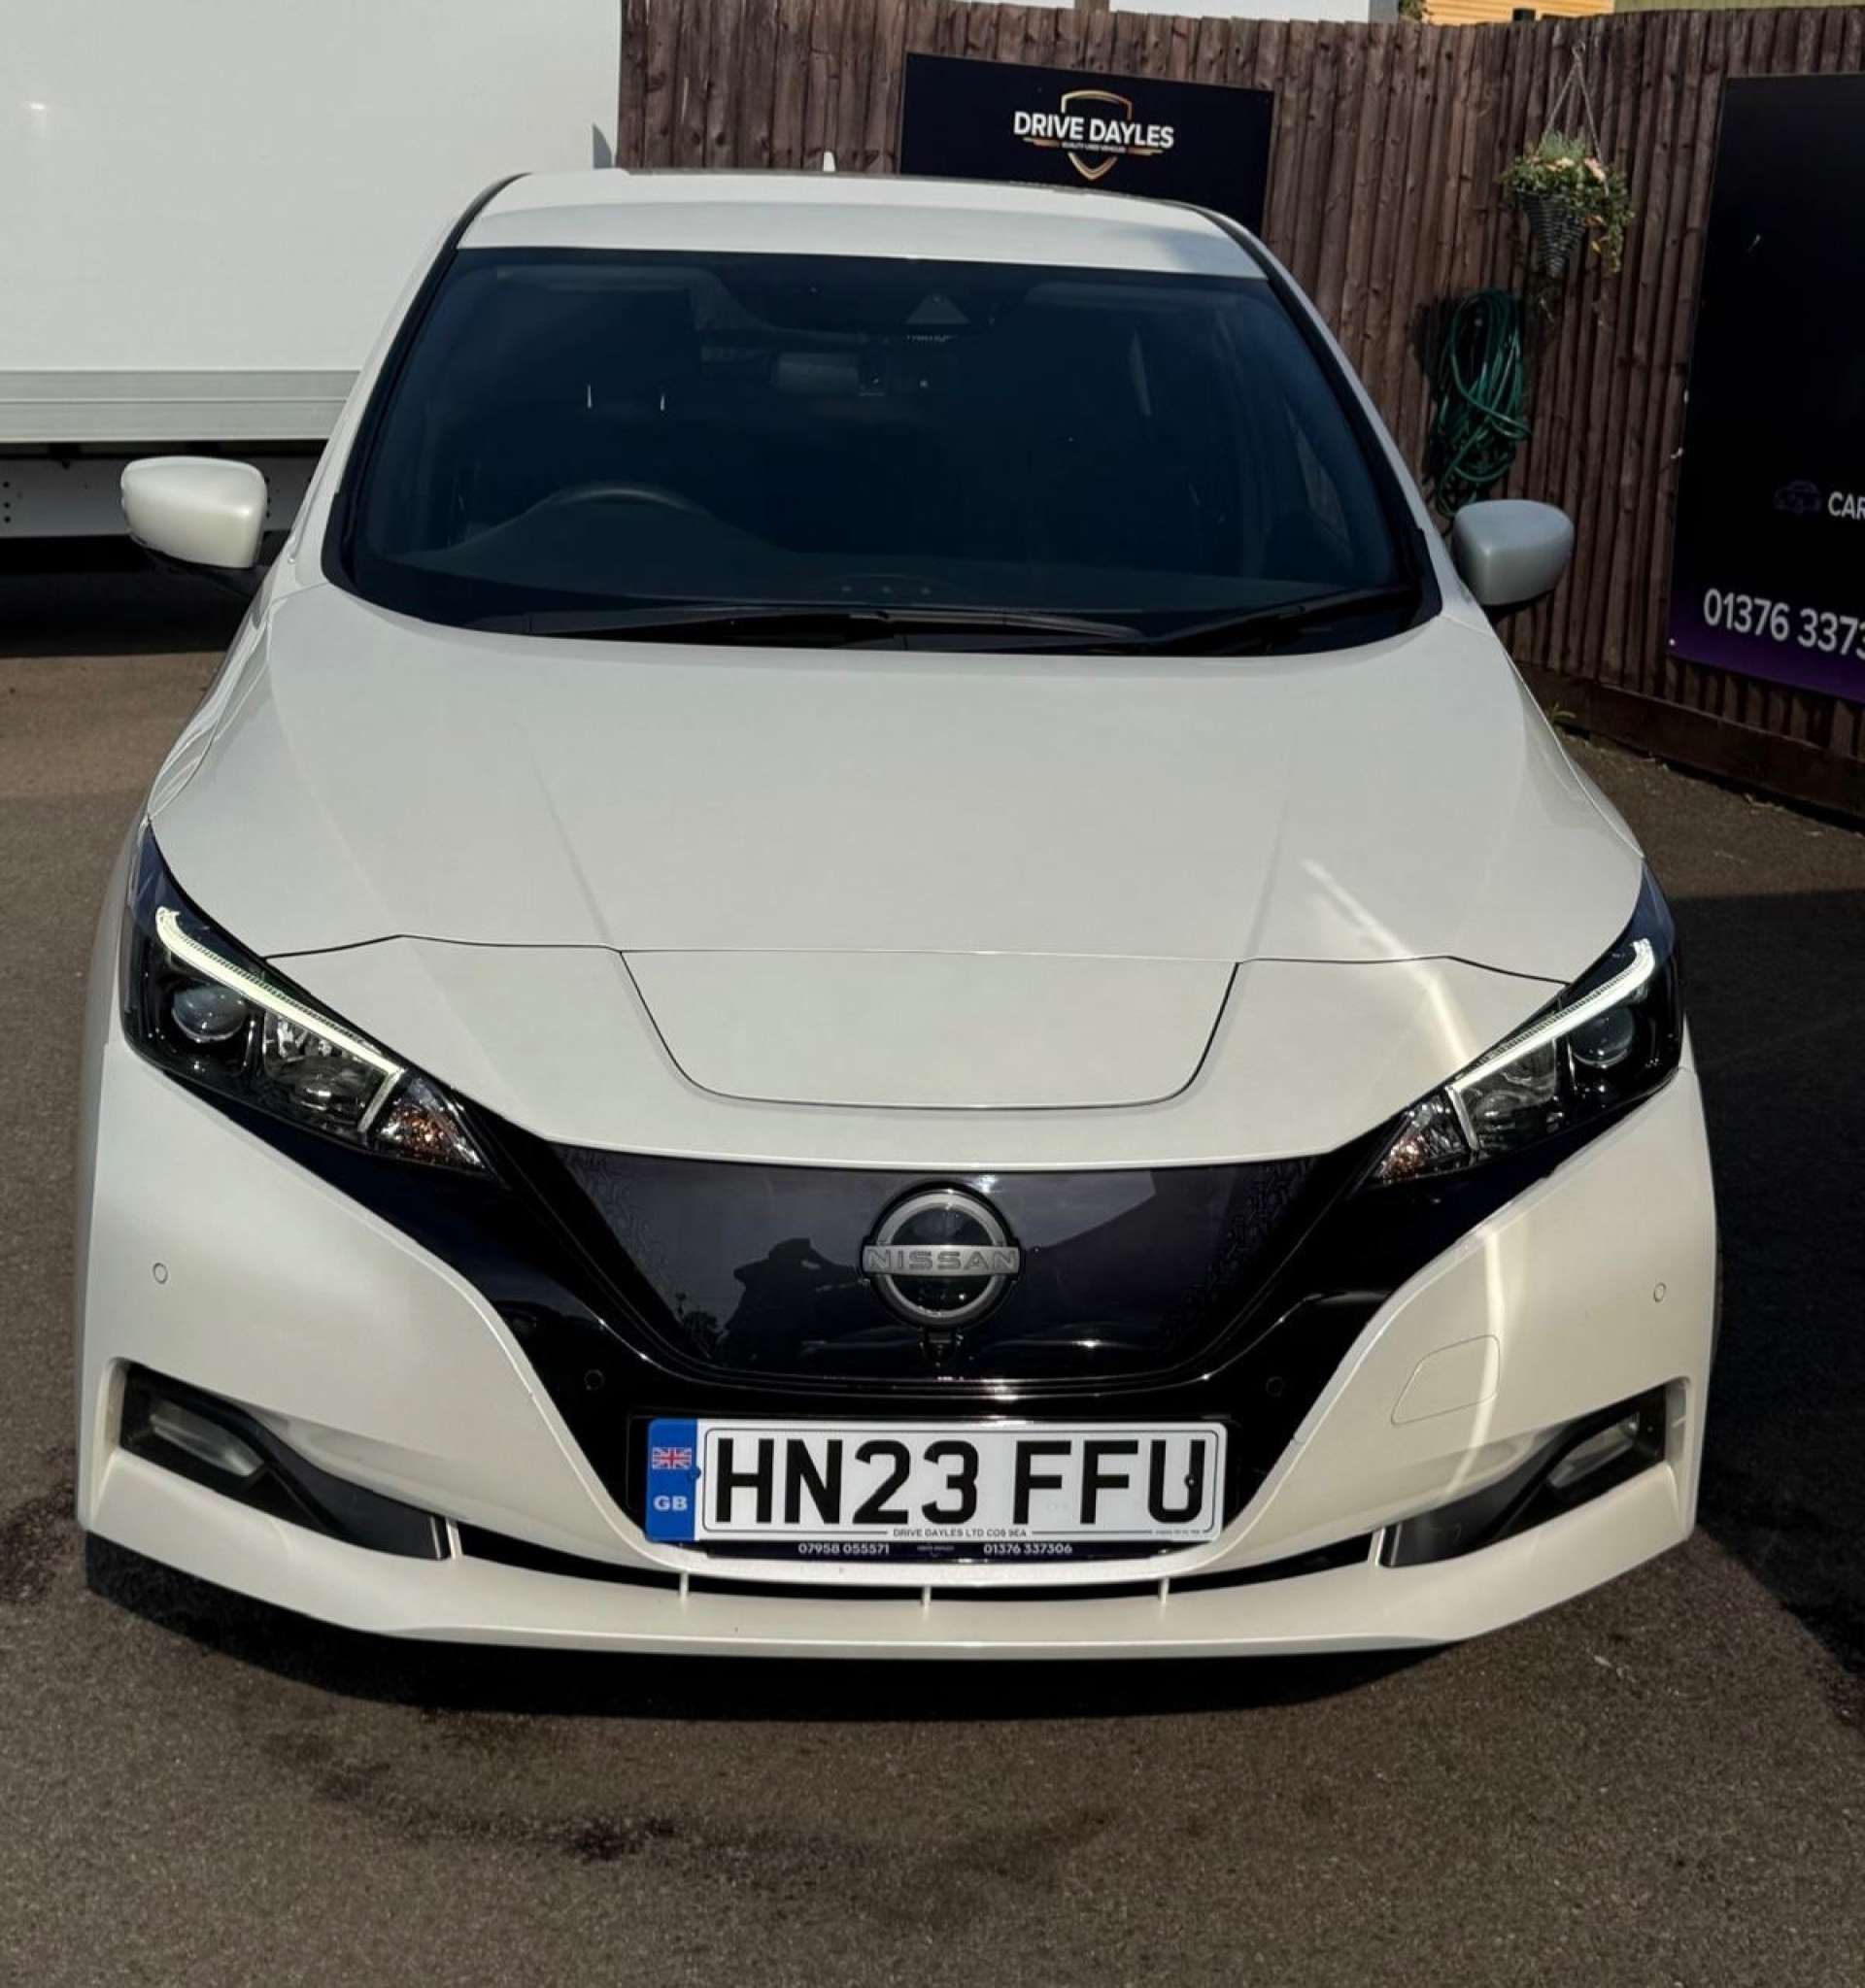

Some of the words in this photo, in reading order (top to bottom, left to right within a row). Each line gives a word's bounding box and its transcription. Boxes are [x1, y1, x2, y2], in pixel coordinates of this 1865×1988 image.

[1013, 111, 1085, 140] DRIVE
[1089, 118, 1174, 149] DAYLES
[1703, 588, 1790, 642] 01376
[867, 1249, 1017, 1271] NISSAN
[715, 1437, 979, 1525] HN23
[1013, 1439, 1206, 1525] FFU
[653, 1495, 688, 1511] GB
[893, 1529, 922, 1537] DRIVE
[924, 1529, 964, 1537] DAYLES
[965, 1529, 984, 1537] LTD
[797, 1542, 840, 1554] 07958
[983, 1542, 1021, 1555] 01376
[1023, 1542, 1073, 1555] 337306
